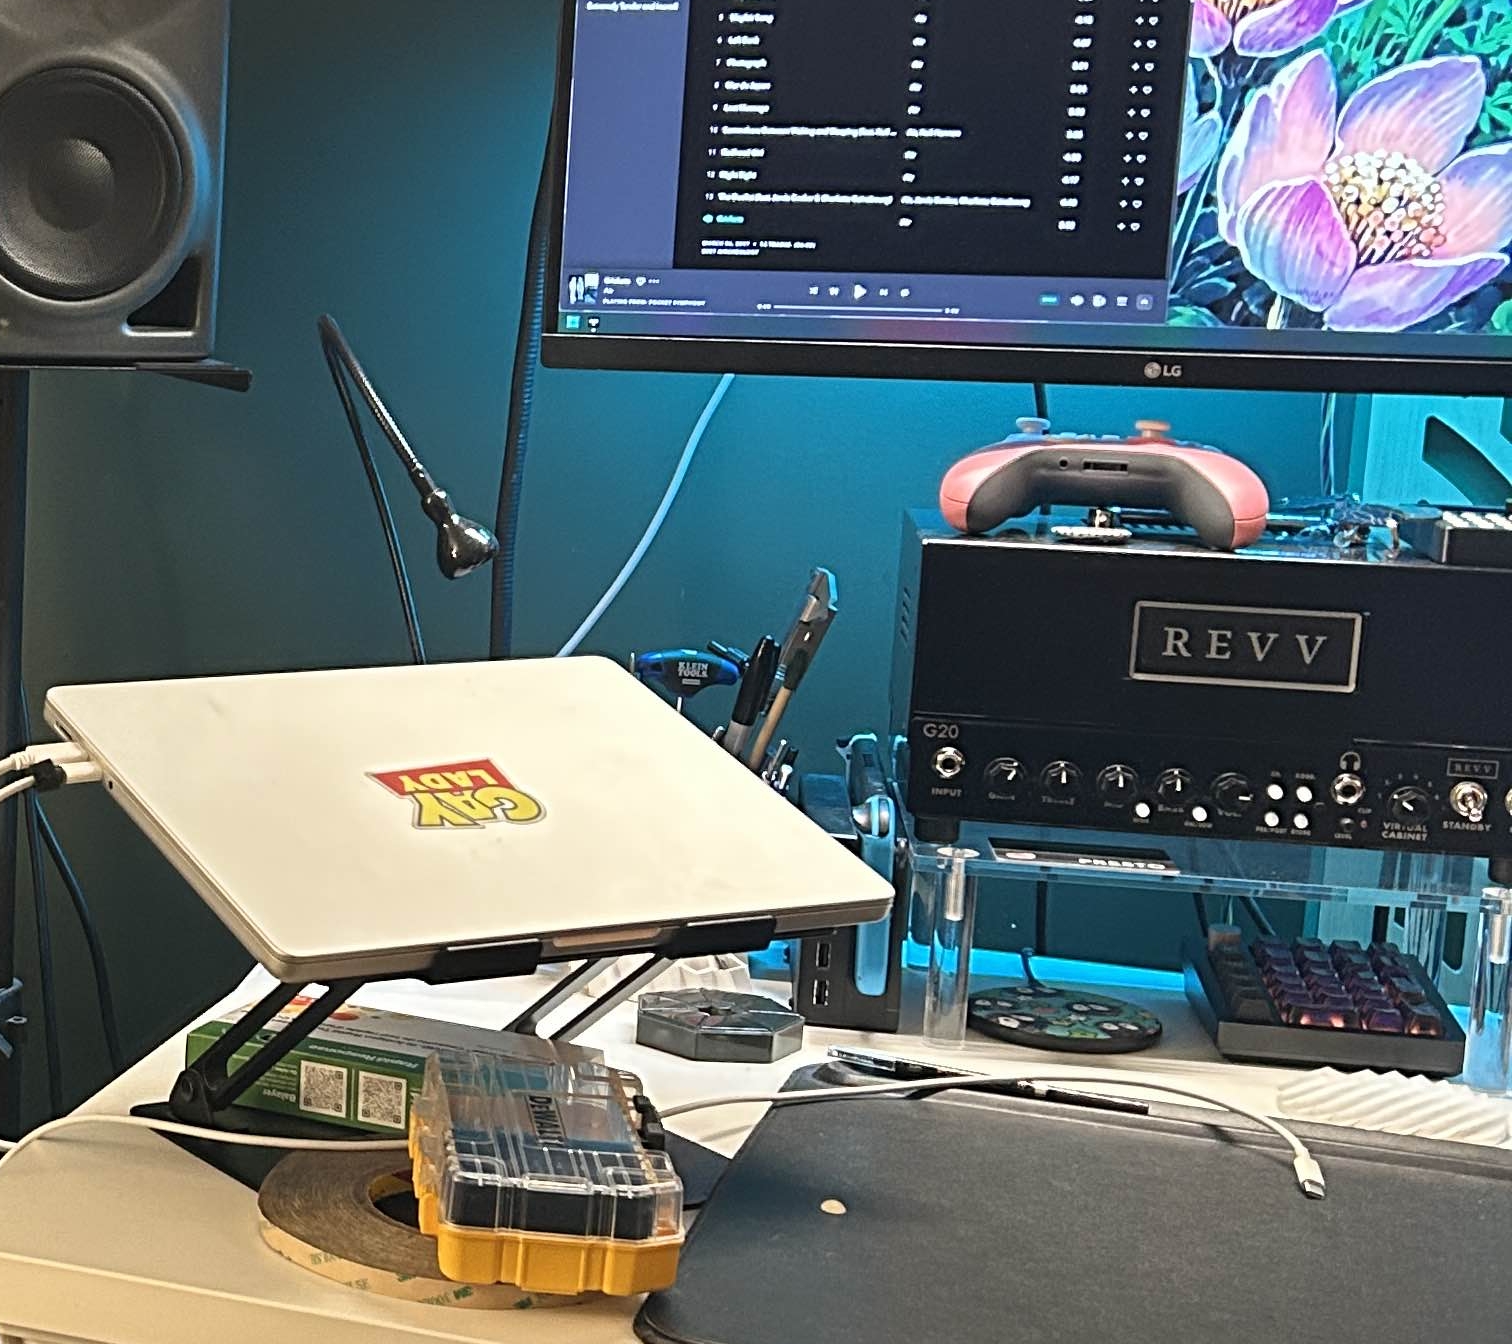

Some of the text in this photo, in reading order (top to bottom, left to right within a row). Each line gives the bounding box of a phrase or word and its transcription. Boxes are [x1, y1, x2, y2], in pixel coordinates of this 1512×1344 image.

[1162, 364, 1183, 378] LG
[1160, 625, 1330, 666] REVV
[678, 662, 709, 671] KLEIN
[678, 668, 709, 678] TOOLS
[923, 723, 960, 739] G20
[398, 768, 499, 793] LADY
[931, 787, 963, 798] INPUT
[411, 785, 543, 827] GAY
[1383, 821, 1428, 833] VIRTUAL
[1442, 820, 1492, 832] STANDBY
[1381, 831, 1428, 842] CABINET
[1077, 857, 1166, 870] PRESTO
